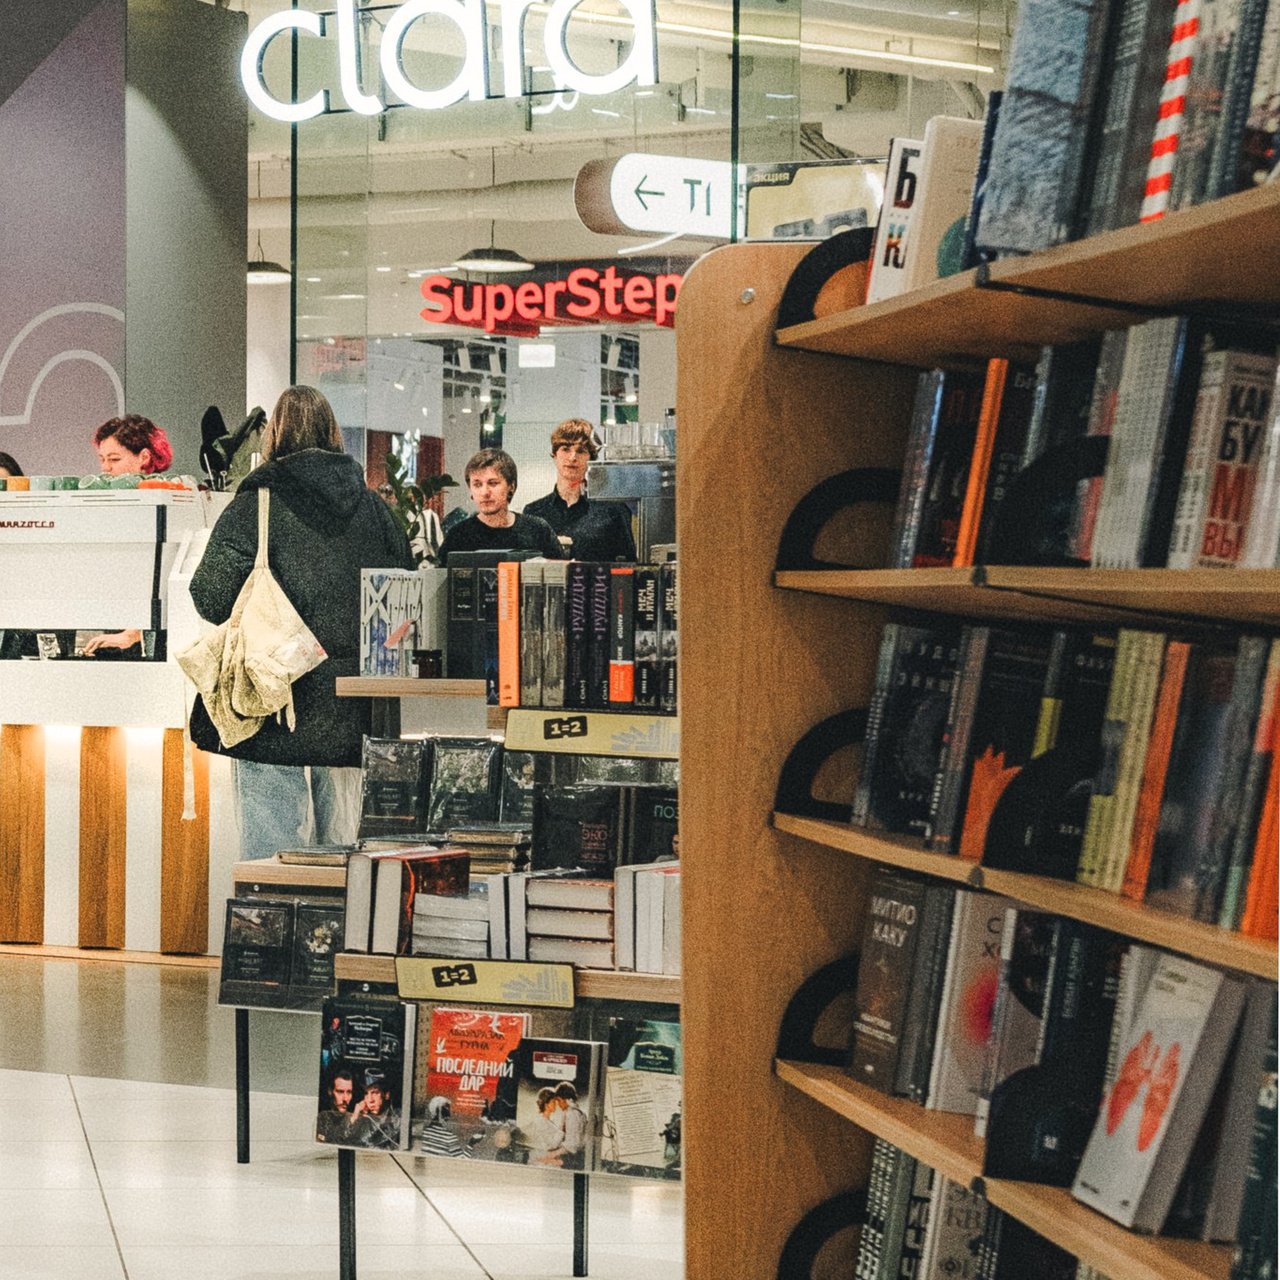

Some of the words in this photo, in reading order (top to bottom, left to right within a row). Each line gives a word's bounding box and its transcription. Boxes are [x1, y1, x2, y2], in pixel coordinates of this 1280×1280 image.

[753, 172, 790, 183] акция
[420, 266, 682, 331] SuperStep
[573, 575, 586, 632] РУШДИ
[595, 575, 608, 632] РУШДИ
[638, 589, 646, 612] МЕЧ
[645, 580, 655, 612] ЯТАГАН
[665, 588, 674, 611] МЕЧ
[550, 721, 581, 735] 1=2
[439, 969, 470, 983] 1=2
[436, 1057, 514, 1078] ПОСЛЕДНИЙ
[459, 1076, 485, 1091] ДАР
